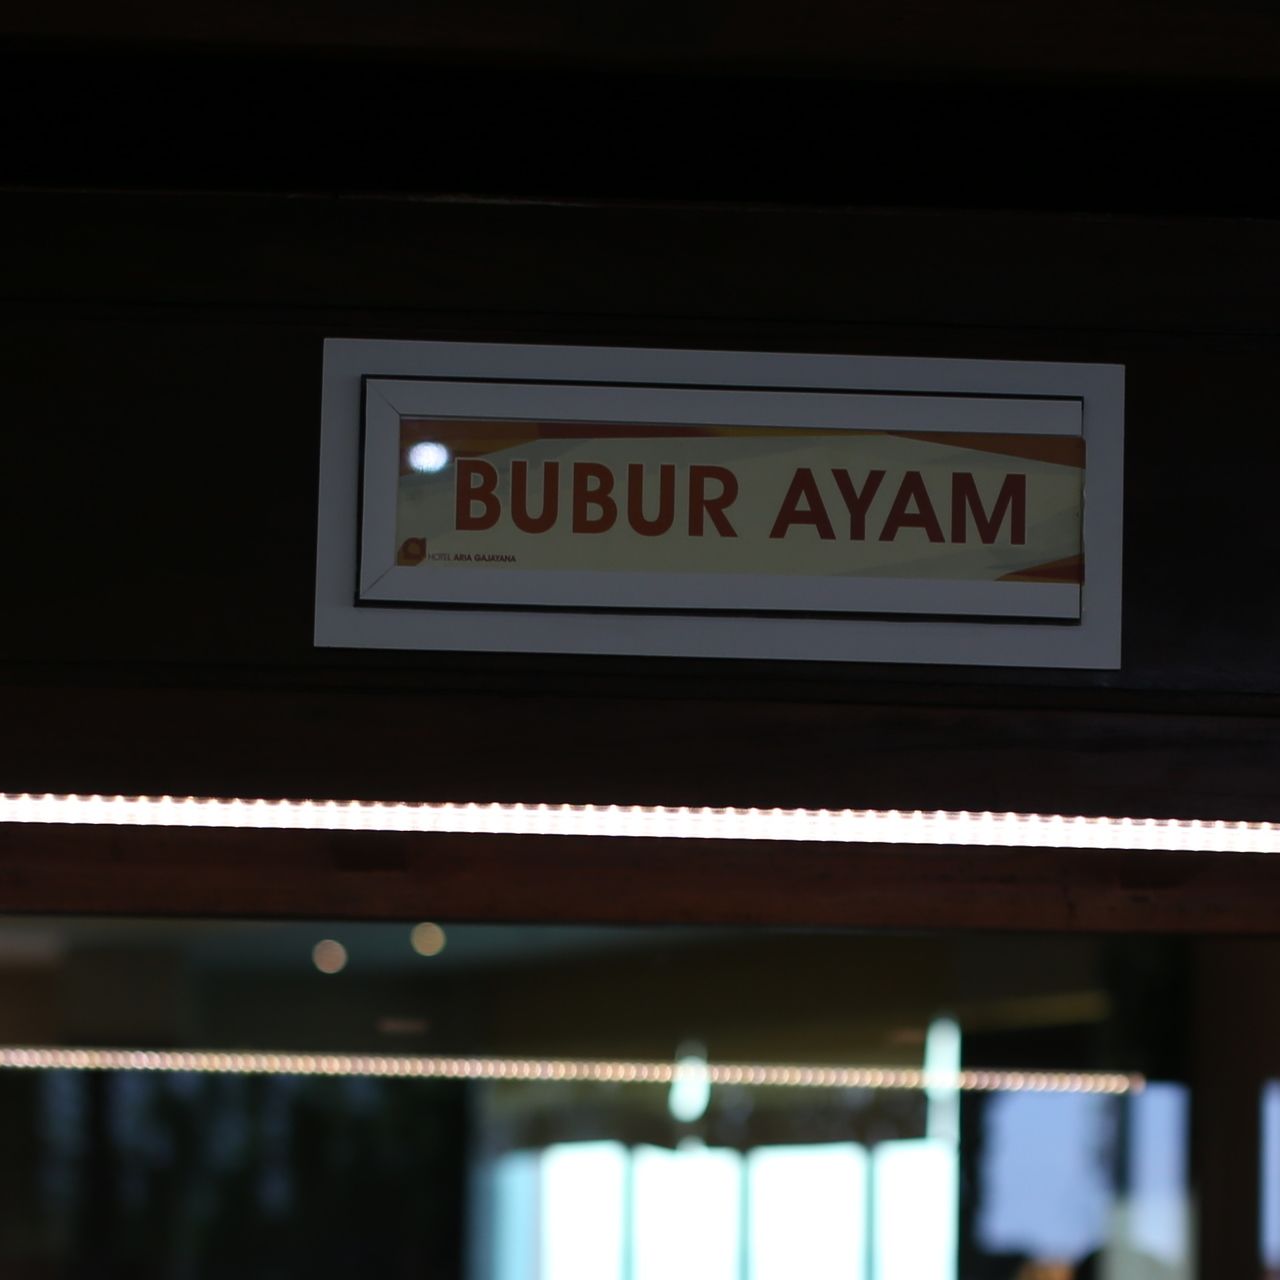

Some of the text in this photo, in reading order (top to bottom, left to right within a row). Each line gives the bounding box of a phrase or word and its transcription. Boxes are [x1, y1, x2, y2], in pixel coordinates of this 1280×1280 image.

[455, 458, 1026, 545] BUBUR AYAM
[427, 553, 517, 563] HOTEL ARIA GAJAYANA
